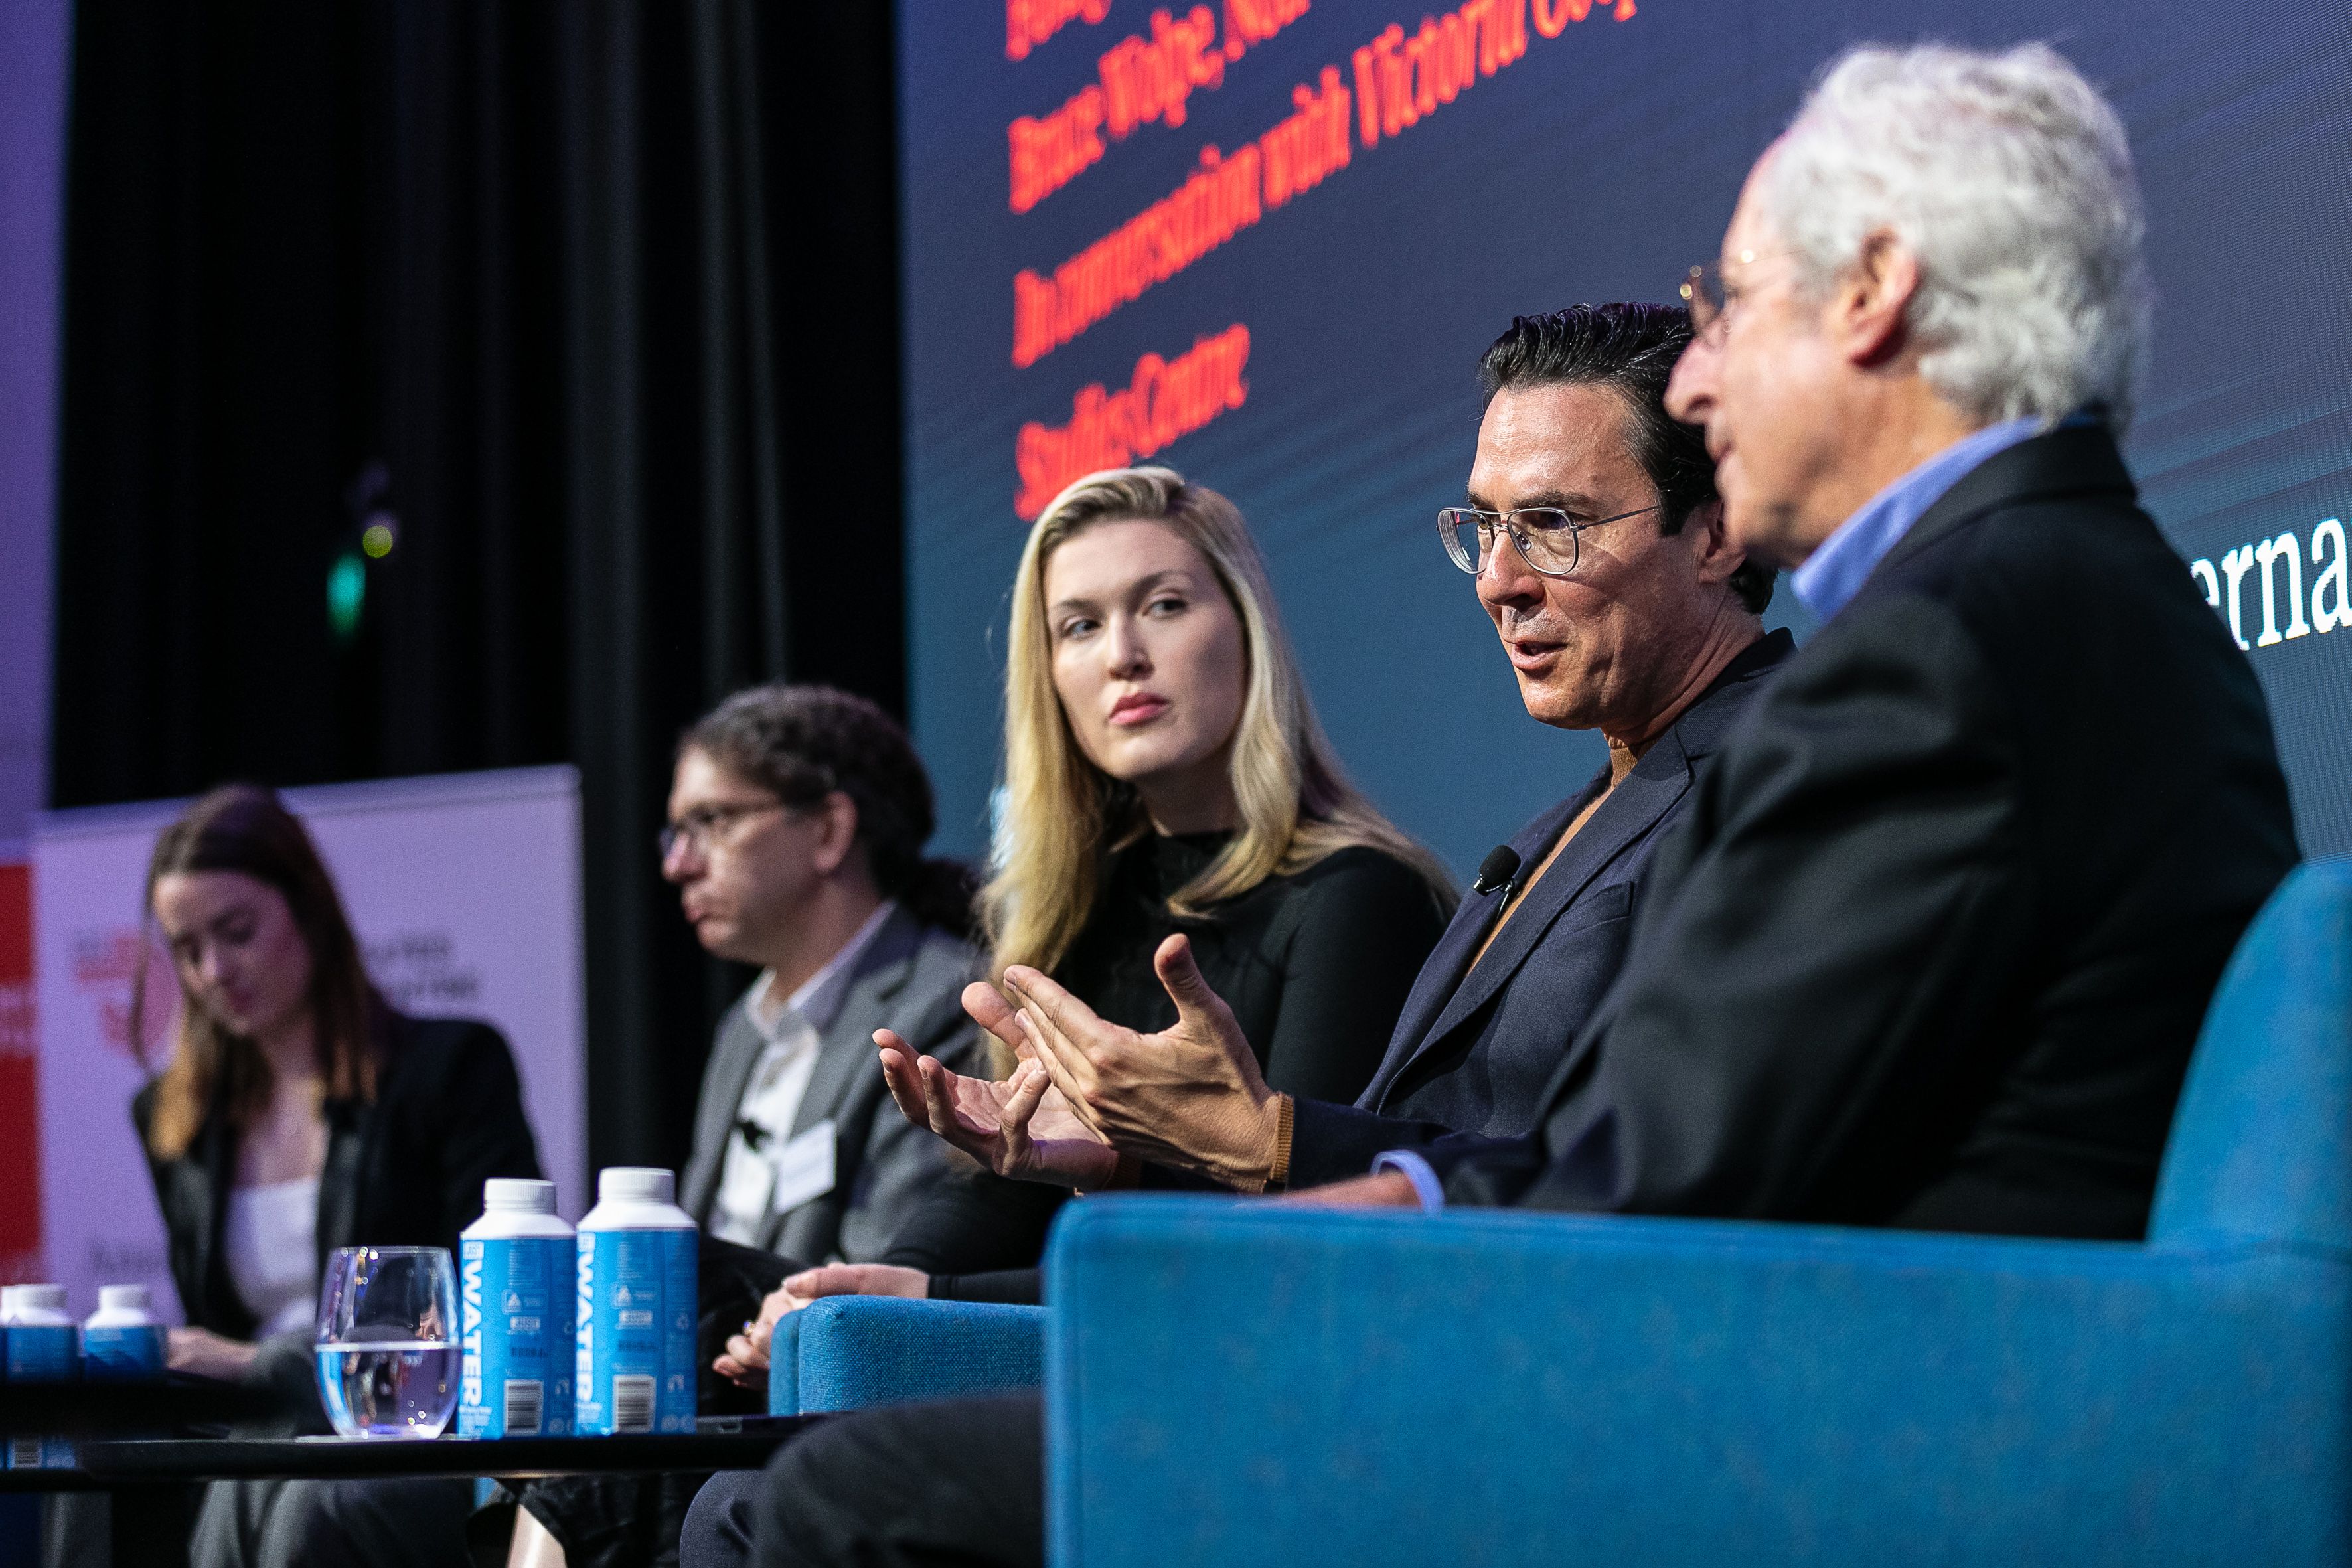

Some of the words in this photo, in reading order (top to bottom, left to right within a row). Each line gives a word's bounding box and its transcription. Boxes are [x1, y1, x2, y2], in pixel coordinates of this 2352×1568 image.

[1012, 268, 1056, 369] In
[1053, 142, 1261, 345] conversation
[1260, 65, 1352, 208] with
[1352, 0, 1528, 147] Victoria
[1129, 323, 1251, 458] Centre
[462, 1260, 483, 1407] WATER
[576, 1251, 595, 1403] WATER
